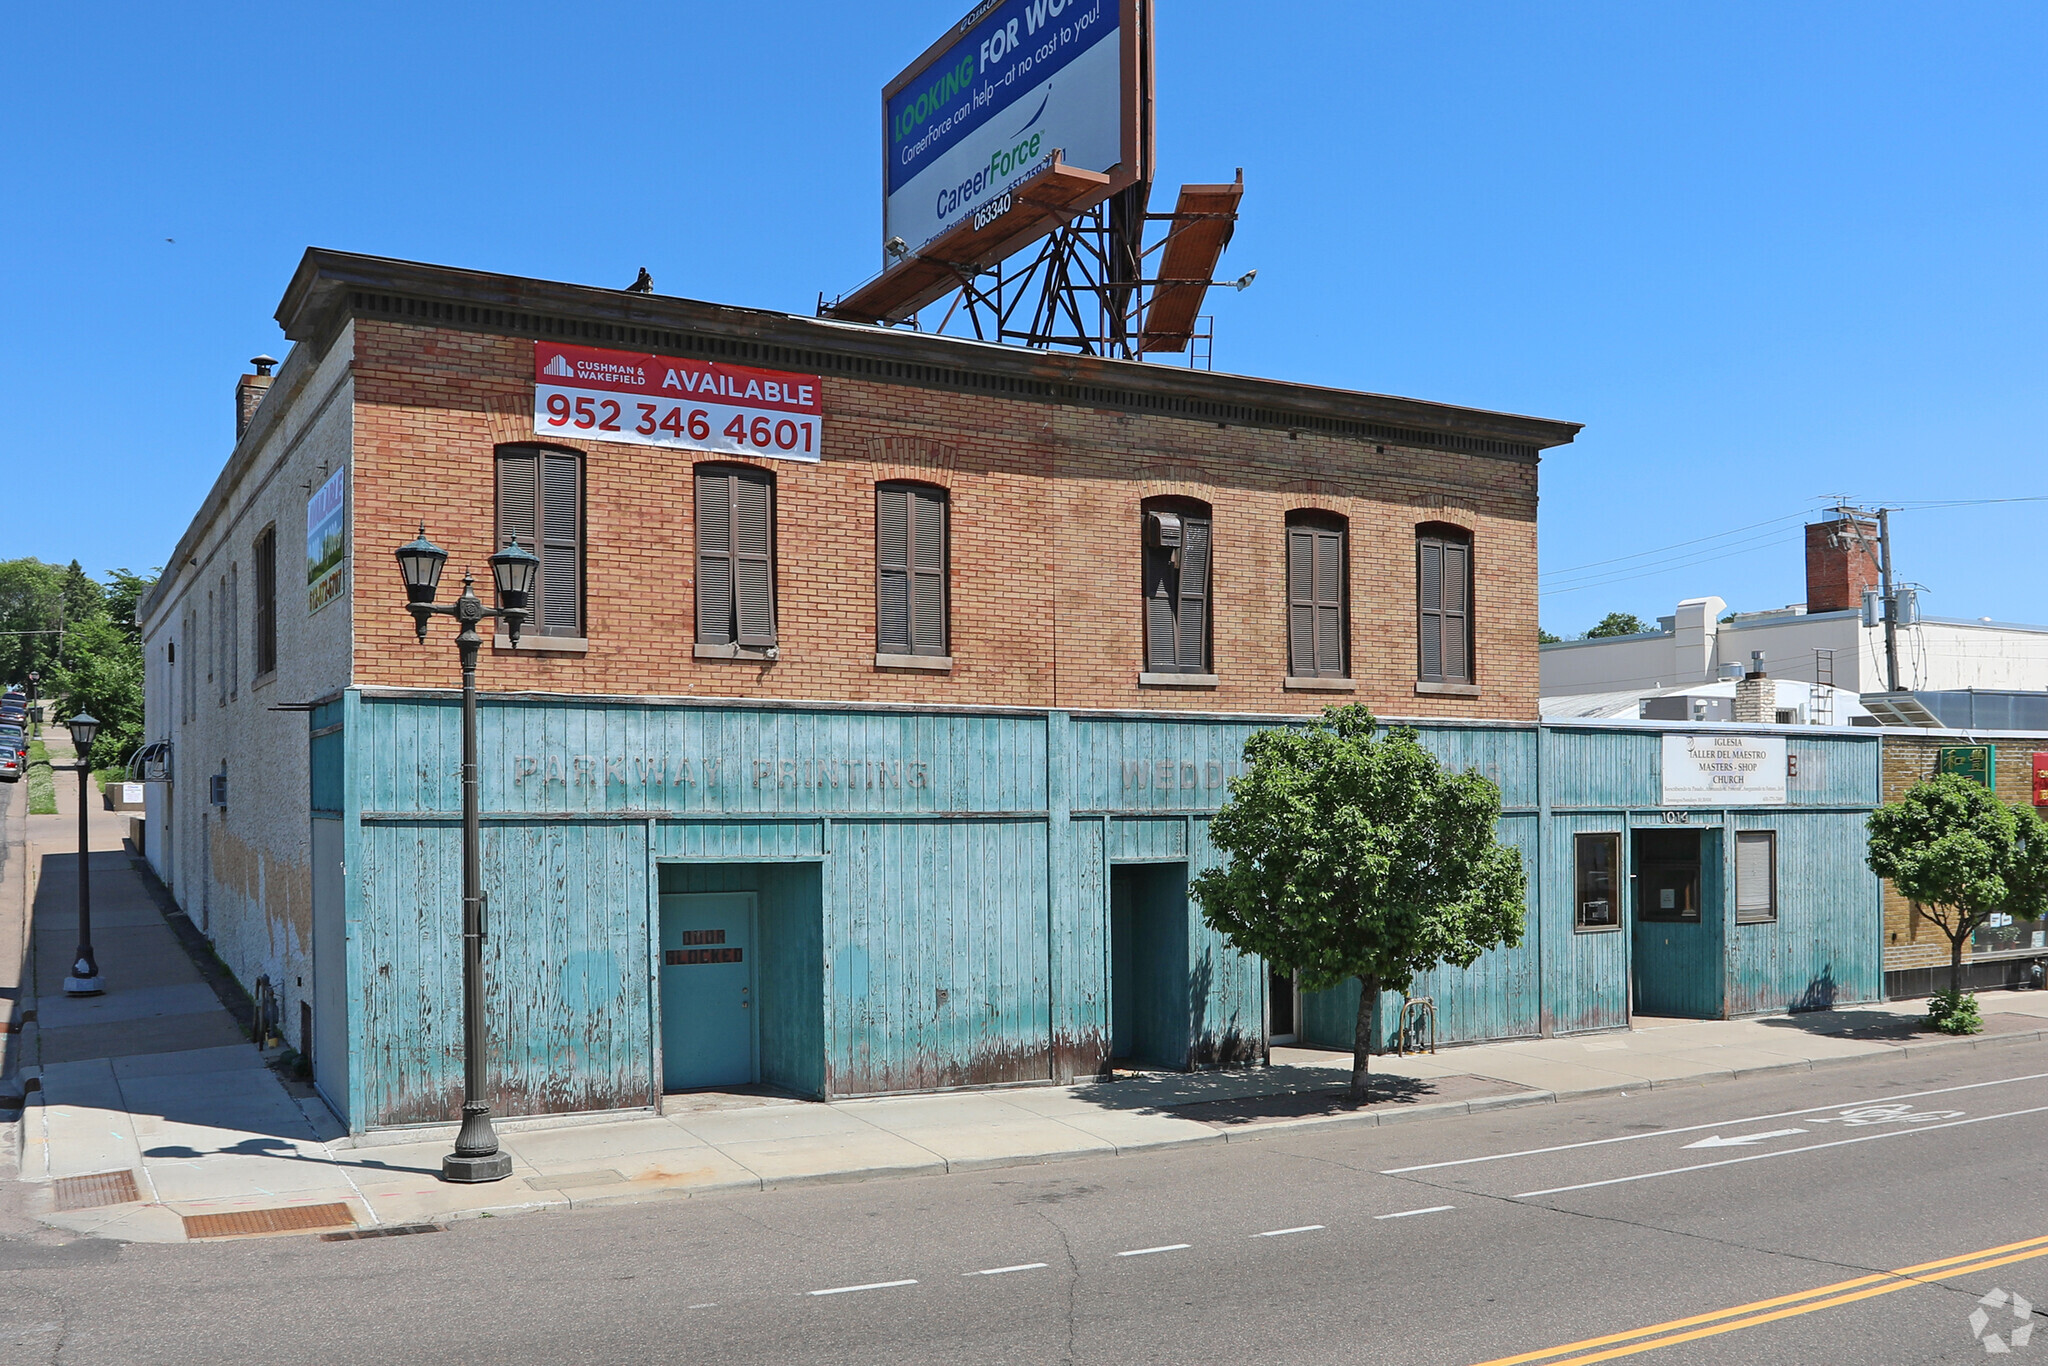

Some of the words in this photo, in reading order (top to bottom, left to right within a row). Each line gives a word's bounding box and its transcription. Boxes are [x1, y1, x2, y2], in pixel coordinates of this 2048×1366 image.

[895, 54, 974, 143] LOOKING
[979, 17, 1020, 75] FOR
[1025, 0, 1073, 36] WO
[901, 116, 951, 165] CareerForce
[953, 103, 970, 125] can
[1018, 57, 1032, 76] no
[1035, 33, 1057, 63] cost
[1060, 28, 1071, 46] to
[1074, 0, 1099, 42] you!
[937, 132, 1040, 219] CareerForce
[974, 194, 1011, 231] 063340
[577, 370, 646, 386] WAKEFIELD
[577, 360, 634, 375] CUSHMAN
[637, 367, 645, 377] &
[662, 368, 814, 407] AVAILABLE
[546, 393, 621, 432] 952
[635, 403, 710, 441] 346
[723, 414, 812, 453] 4601
[1714, 738, 1742, 747] IGLESIA
[1717, 750, 1731, 759] DEL
[1732, 751, 1766, 760] MAESTRO
[514, 755, 722, 787] PARKWAY
[752, 759, 928, 789] PRINTING
[1699, 763, 1733, 771] MASTERS
[1738, 763, 1757, 772] SHOP
[1712, 775, 1744, 784] CHURCH
[666, 948, 742, 965] BLOCKED
